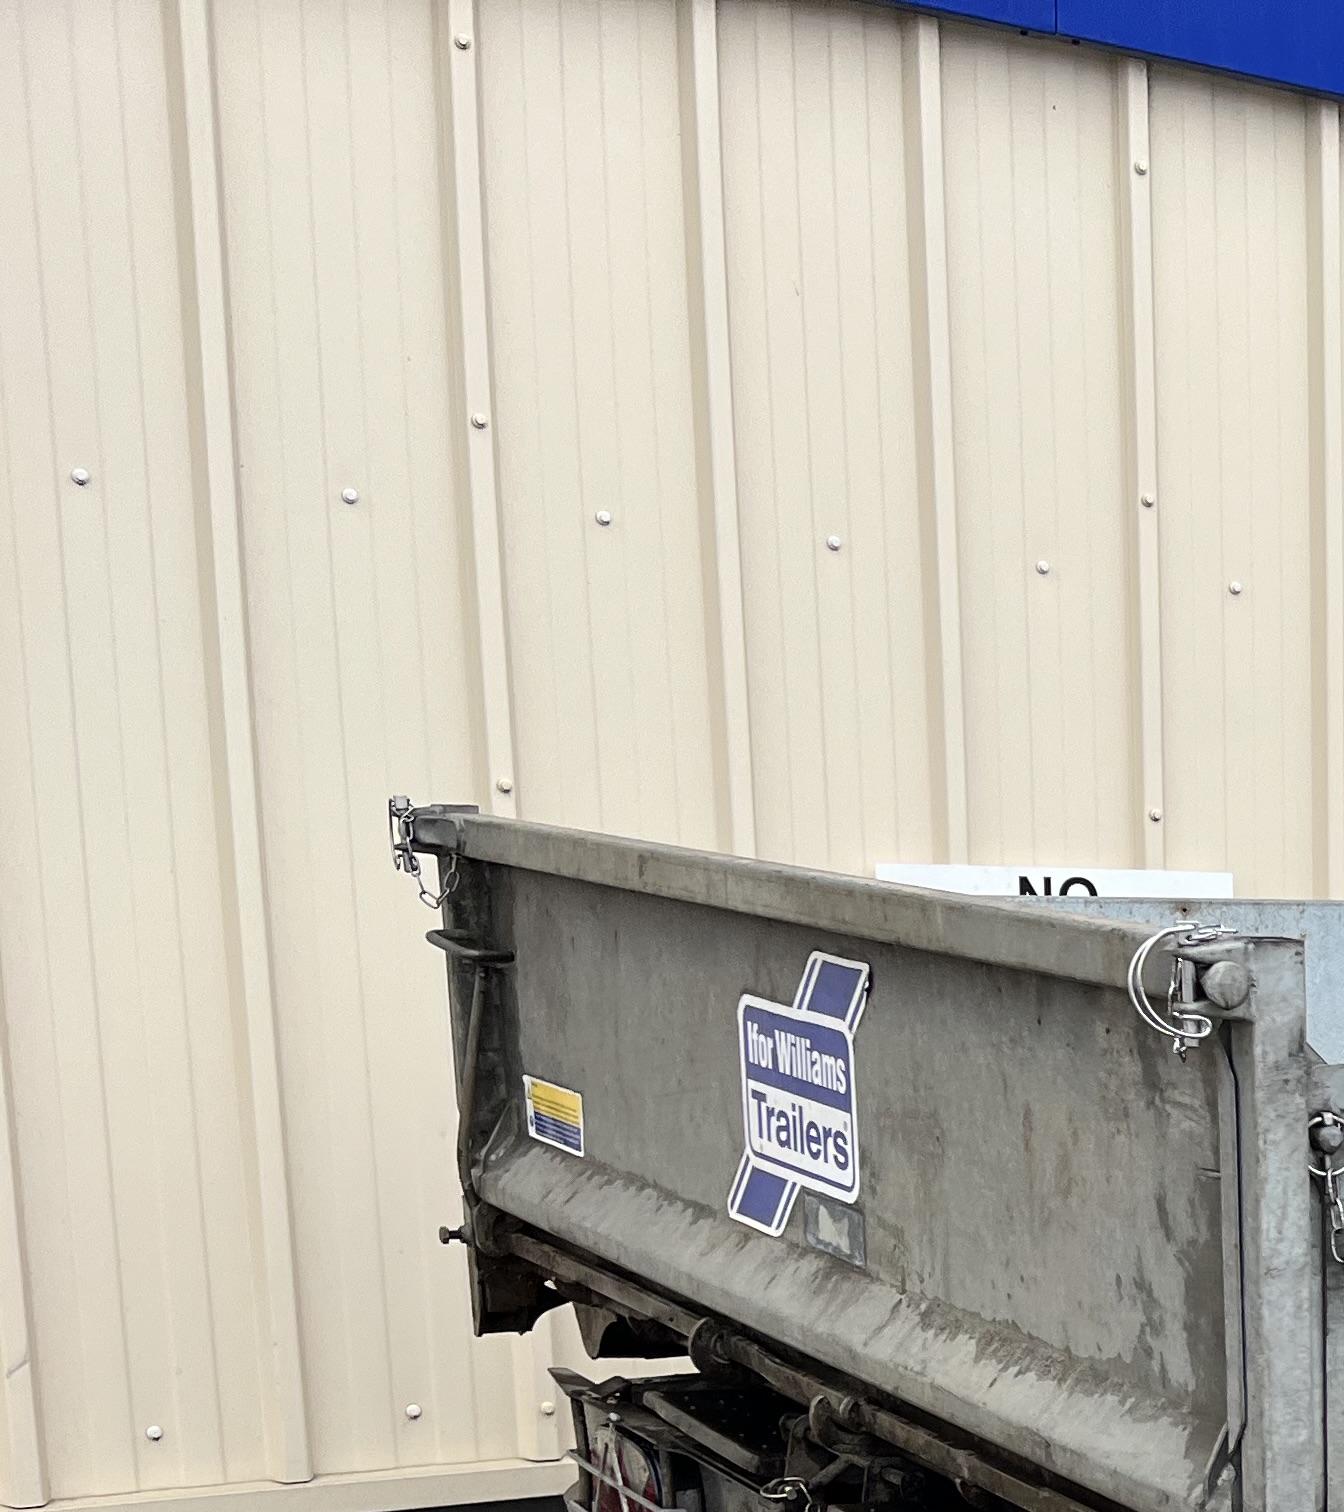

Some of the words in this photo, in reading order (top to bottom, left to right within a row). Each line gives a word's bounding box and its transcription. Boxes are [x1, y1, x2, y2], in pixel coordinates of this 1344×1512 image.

[746, 1020, 775, 1070] Ifor
[774, 1029, 848, 1095] Williams
[751, 1089, 849, 1171] Trailers
